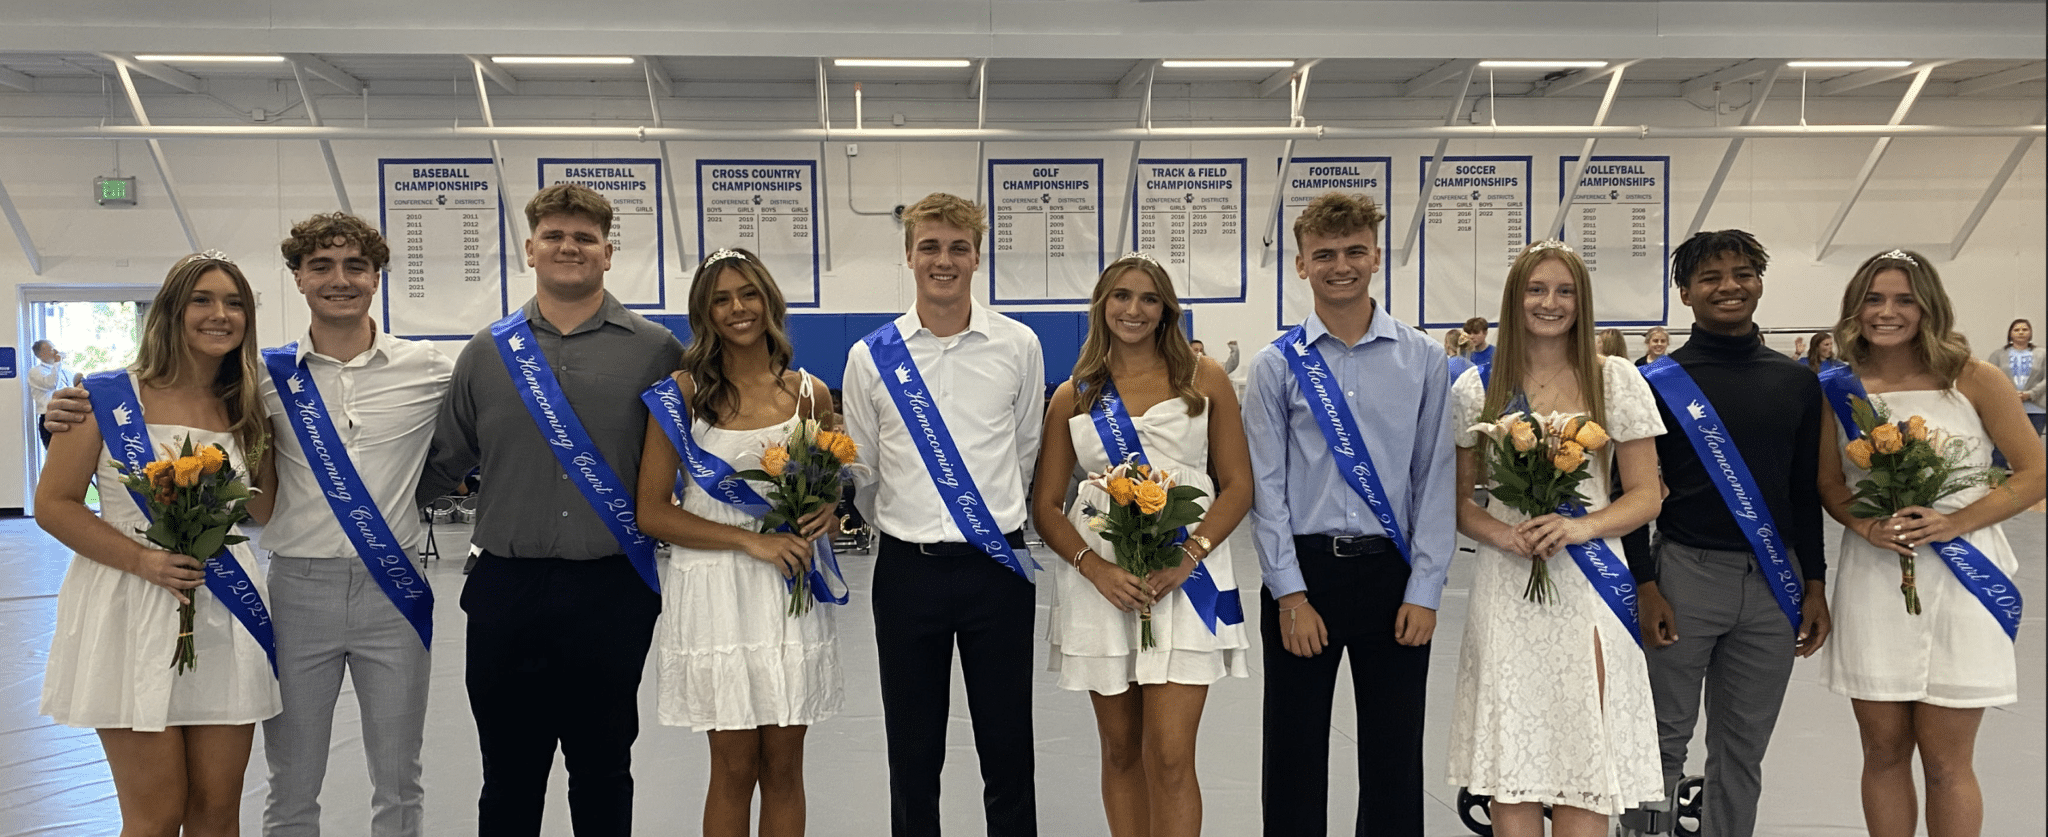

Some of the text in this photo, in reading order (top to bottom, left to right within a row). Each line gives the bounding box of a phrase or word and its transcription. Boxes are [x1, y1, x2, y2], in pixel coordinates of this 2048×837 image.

[413, 169, 469, 178] BASEBALL
[566, 168, 634, 178] BASKETBALL
[712, 169, 801, 178] CROSS COUNTRY
[1033, 168, 1059, 177] GOLF
[1152, 168, 1227, 177] TRACK & FIELD
[1310, 167, 1359, 176] FOOTBALL
[1456, 166, 1495, 174] SOCCER
[395, 181, 488, 191] CHAMPIONSHIPS
[712, 182, 802, 191] CHAMPIONSHIPS
[1003, 181, 1089, 190] CHAMPIONSHIPS
[1147, 181, 1232, 189] CHAMPIONSHIPS
[1292, 179, 1377, 188] CHAMPIONSHIPS
[1434, 178, 1518, 186] CHAMPIONSHIPS
[1580, 178, 1655, 186] HAMPIONSHIPS
[516, 355, 574, 450] Homecoming
[572, 452, 613, 494] Court
[655, 386, 716, 479] Homecoming
[1302, 361, 1354, 458] Homecoming
[1352, 462, 1382, 506] Court
[904, 388, 959, 489] Homecoming
[956, 492, 990, 536] Court
[295, 399, 423, 599] Homecoming Court 2024
[1698, 424, 1800, 606] Homecoming Court 202
[1941, 542, 1990, 582] Court
[228, 580, 268, 626] 2024
